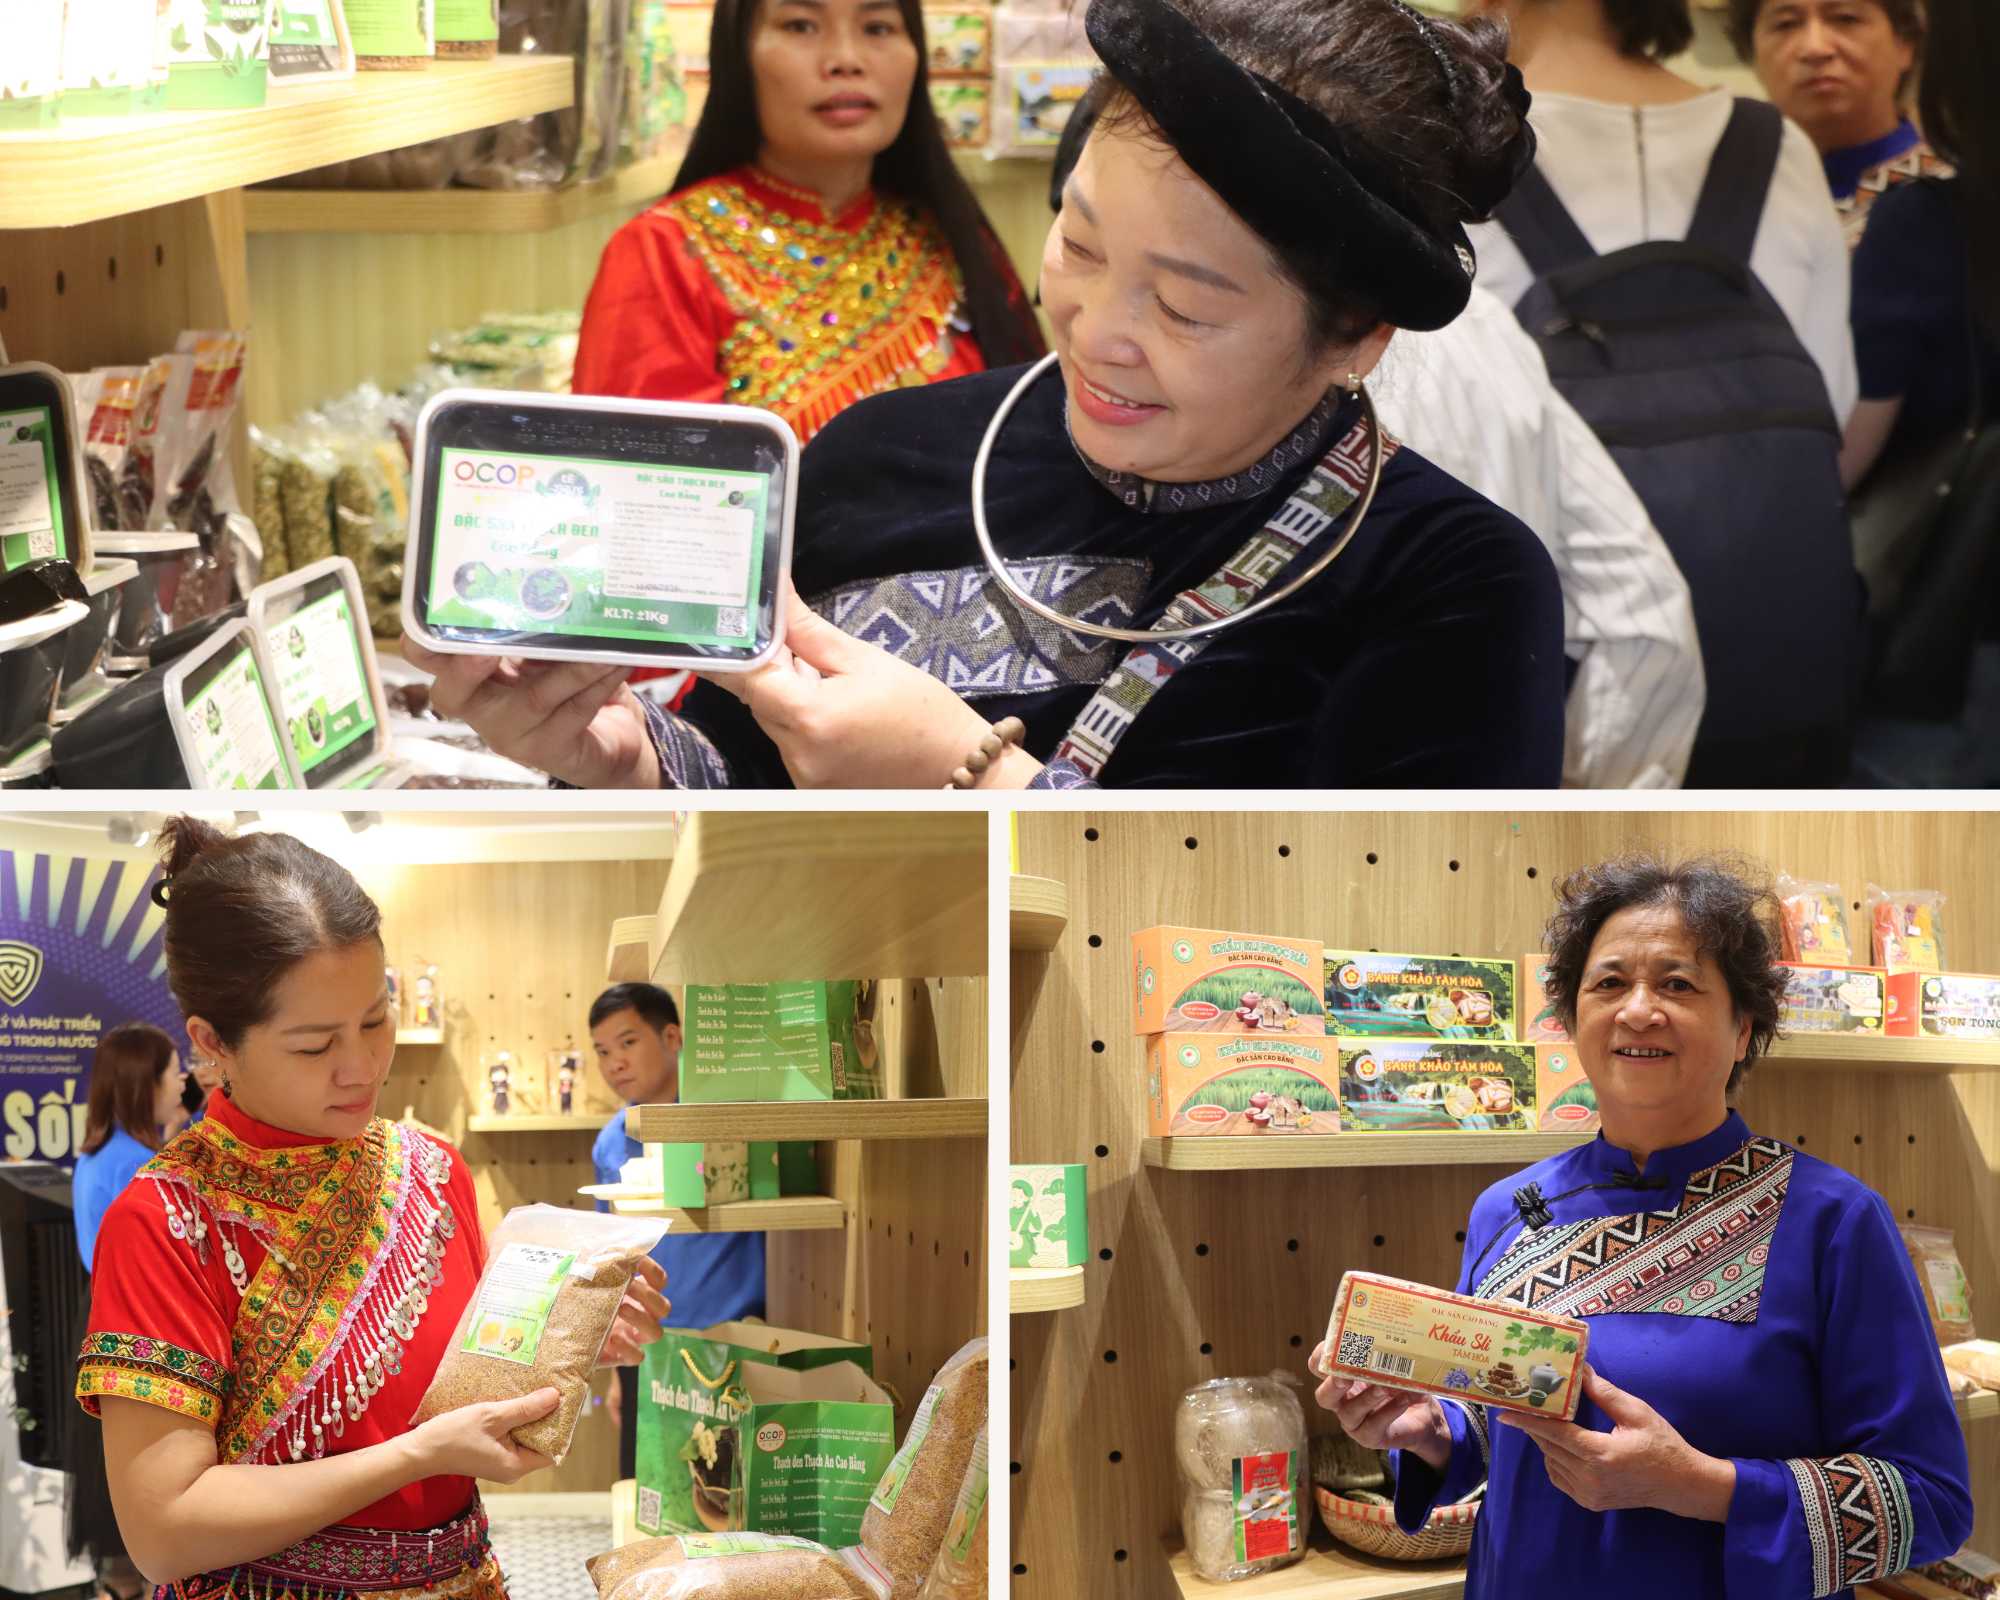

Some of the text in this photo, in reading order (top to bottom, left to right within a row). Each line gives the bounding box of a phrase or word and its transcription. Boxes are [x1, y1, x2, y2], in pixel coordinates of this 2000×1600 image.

[455, 461, 535, 486] OCOP
[636, 473, 653, 484] ĐẶC
[657, 473, 675, 485] SẢN
[678, 477, 706, 488] THẠCH
[659, 490, 701, 502] Cao Bằng
[454, 512, 482, 530] ĐẶC
[571, 525, 599, 538] ĐEN
[603, 607, 669, 625] KLT: ±1Kg
[1211, 937, 1310, 967] KHẨU SLI NGỌC HẢI
[1266, 955, 1283, 966] BẰNG
[1407, 963, 1424, 971] BẰNG
[1367, 971, 1484, 988] BÁNH KHẢO TÂM HÒA
[1851, 977, 1877, 986] OCOP
[10, 1013, 28, 1029] VÀ
[28, 1014, 60, 1030] PHÁT
[62, 1013, 101, 1031] TRIỂN
[1941, 1016, 1966, 1027] SƠN
[13, 1034, 57, 1048] TRONG
[57, 1032, 98, 1049] NƯỚC
[1218, 1039, 1324, 1064] KHẨU SLI NGỌC HẢI
[1277, 1055, 1295, 1064] BẰNG
[1424, 1050, 1442, 1058] BẰNG
[1383, 1059, 1504, 1073] BÁNH KHẢO TÂM HÒA
[1431, 1308, 1498, 1328] ĐẶC SẢN CAO BẰNG
[1428, 1323, 1492, 1351] Khẩu Sli
[1453, 1348, 1490, 1364] TÂM HÒA
[651, 1379, 675, 1411] Thạch
[675, 1385, 689, 1411] đen
[759, 1431, 783, 1440] OCOP
[773, 1453, 866, 1474] Thạch đen Thạch An Cao Bằng
